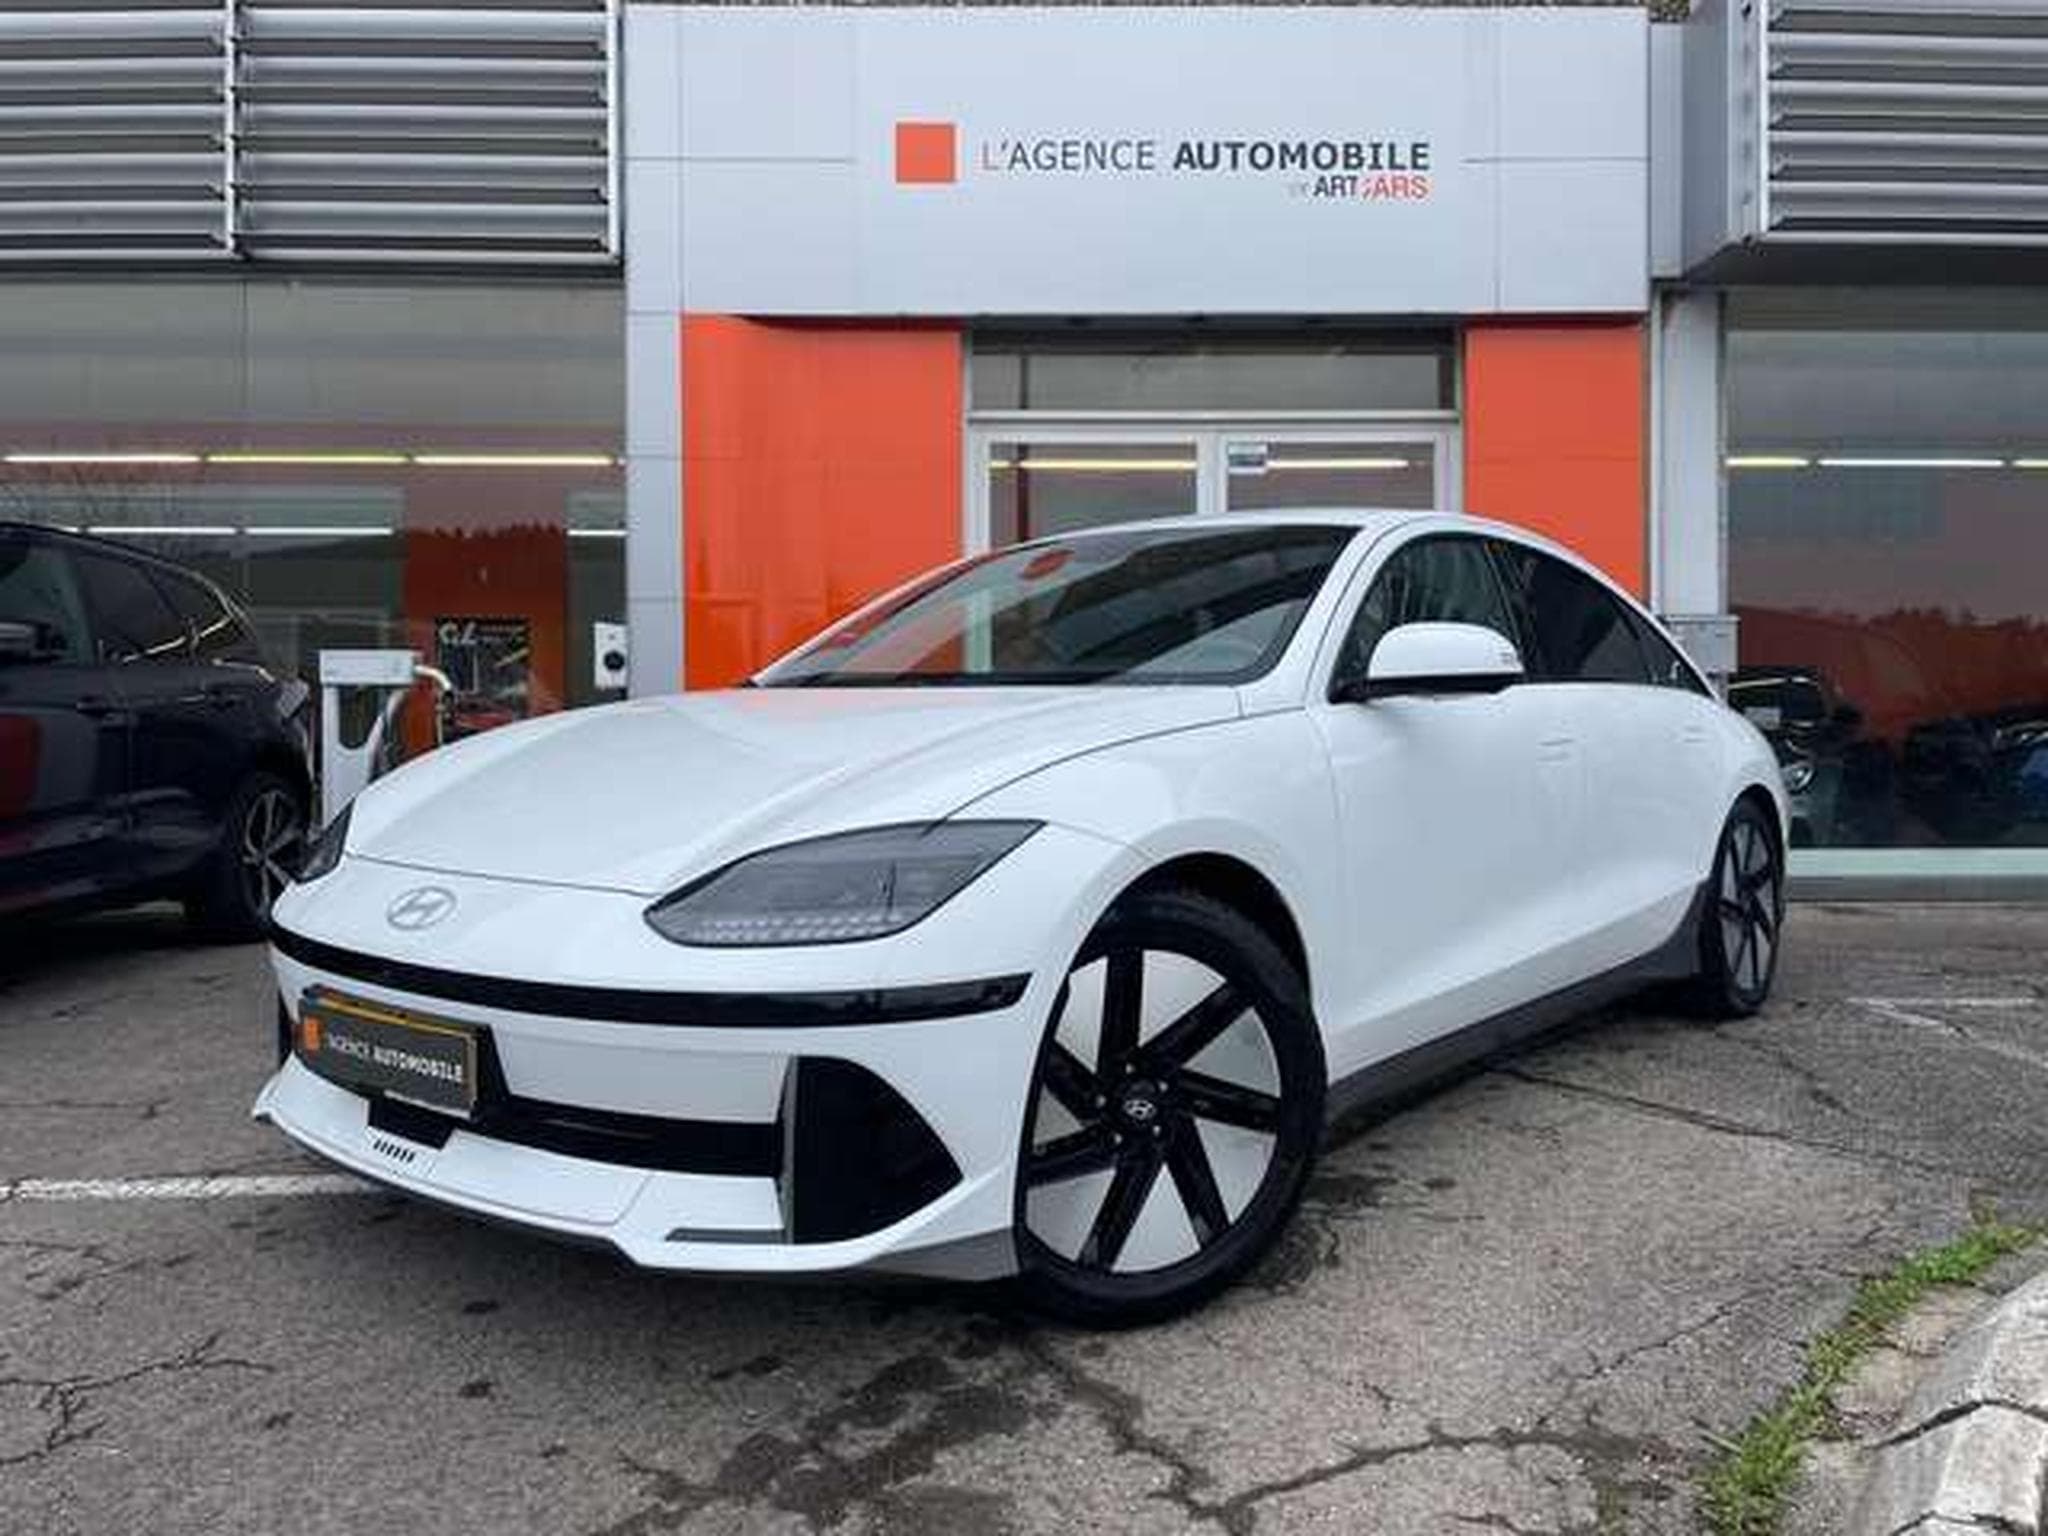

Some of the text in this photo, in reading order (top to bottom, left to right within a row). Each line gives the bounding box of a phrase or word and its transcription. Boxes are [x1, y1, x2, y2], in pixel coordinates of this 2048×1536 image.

[982, 139, 1430, 171] L'AGENCE AUTOMOBILE
[373, 1045, 463, 1083] AUTOMOBILE
